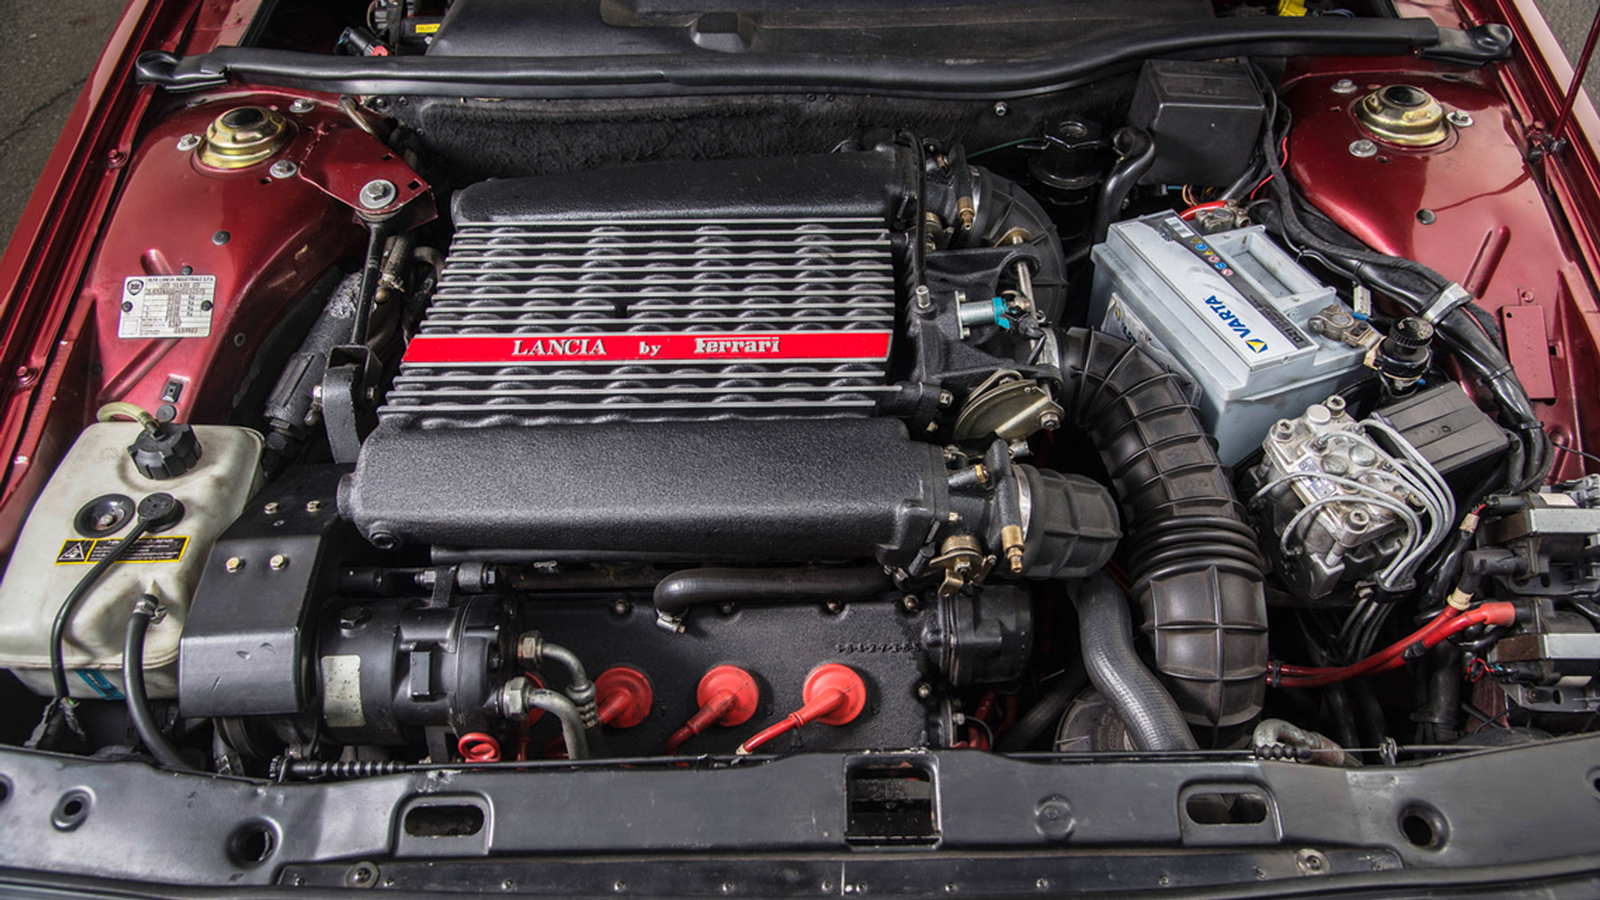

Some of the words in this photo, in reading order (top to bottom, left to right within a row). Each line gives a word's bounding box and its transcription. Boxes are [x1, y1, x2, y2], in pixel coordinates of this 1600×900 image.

[1204, 295, 1251, 339] VARTA
[1284, 328, 1304, 343] D21
[512, 338, 607, 356] LANCIA
[639, 341, 661, 357] by
[694, 337, 781, 354] Ferrari
